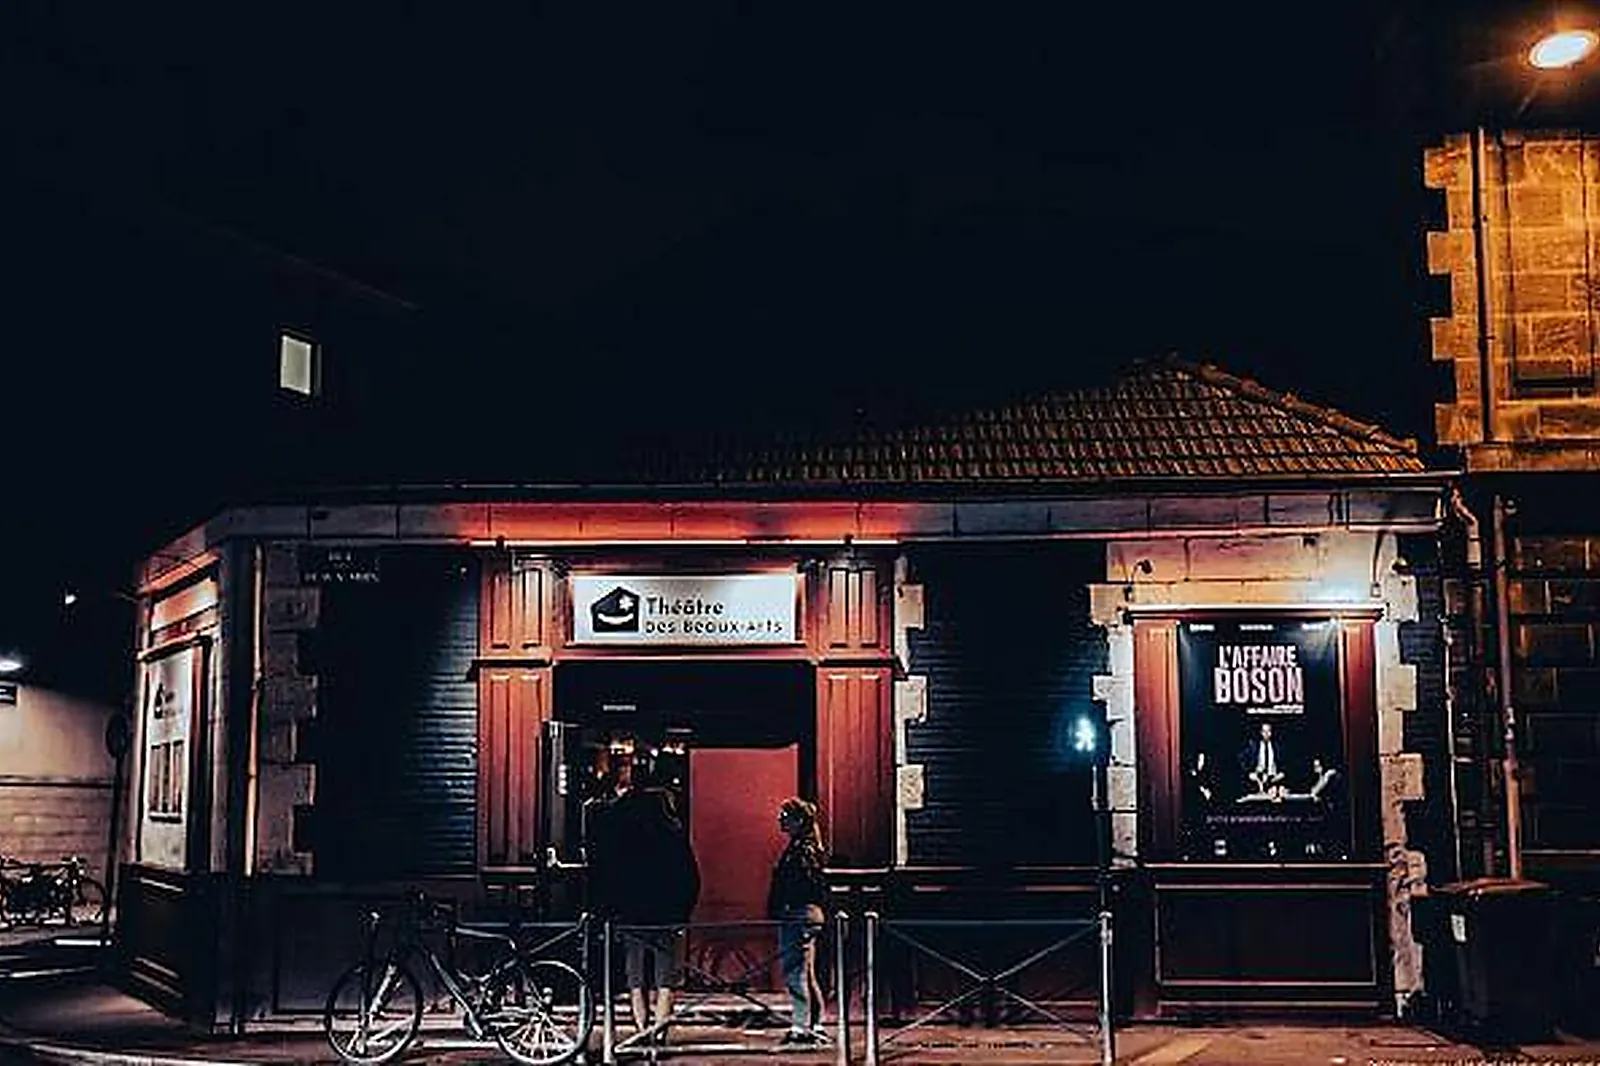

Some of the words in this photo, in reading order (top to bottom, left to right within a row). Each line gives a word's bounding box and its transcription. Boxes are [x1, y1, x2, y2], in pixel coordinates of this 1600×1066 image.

[646, 596, 724, 615] Théâtre
[1219, 645, 1298, 668] L'AFFAIRE
[1214, 667, 1304, 703] BOSON
